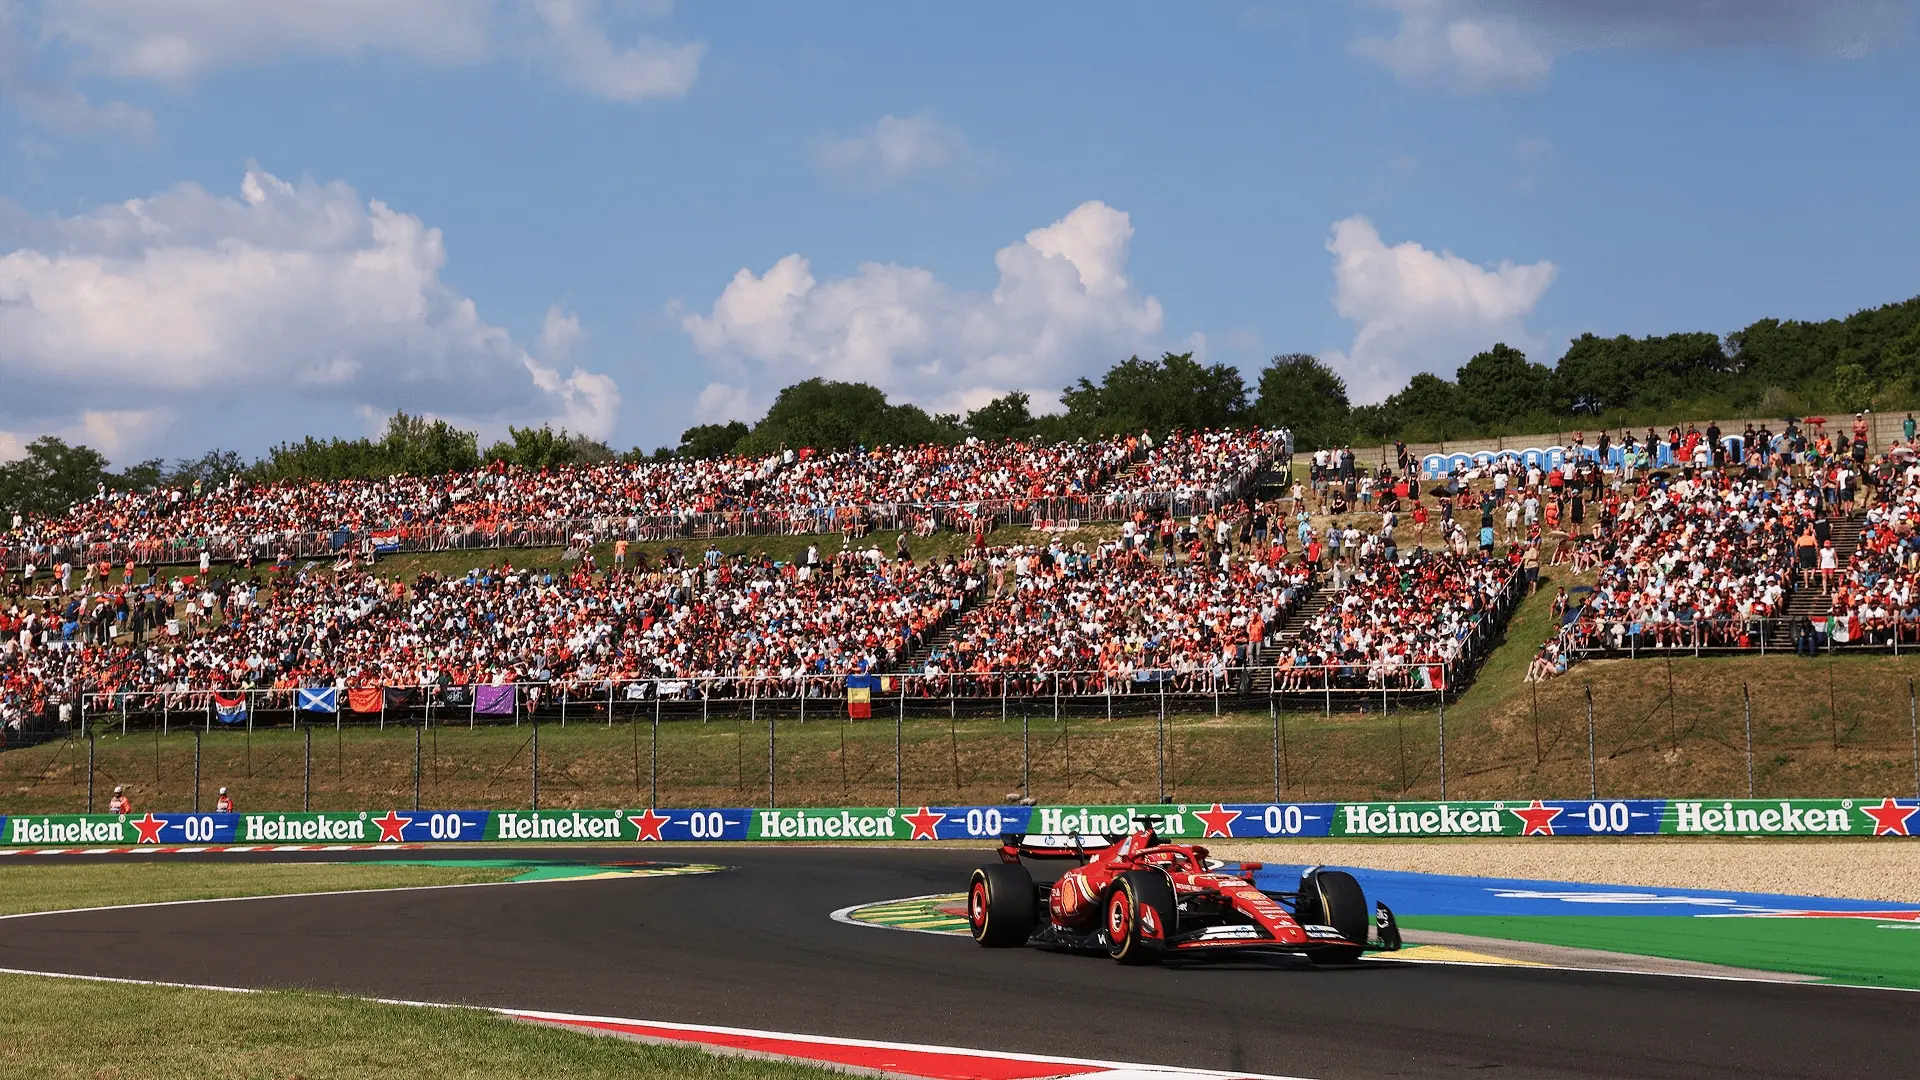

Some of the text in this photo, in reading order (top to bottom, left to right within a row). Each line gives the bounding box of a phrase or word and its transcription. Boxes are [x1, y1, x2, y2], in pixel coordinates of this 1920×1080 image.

[12, 818, 124, 842] Heineken
[246, 815, 365, 841] Heineken
[498, 813, 622, 839] Heineken
[760, 811, 895, 838] Heineken
[1344, 805, 1503, 833] Heineken
[1676, 803, 1851, 832] Heineken
